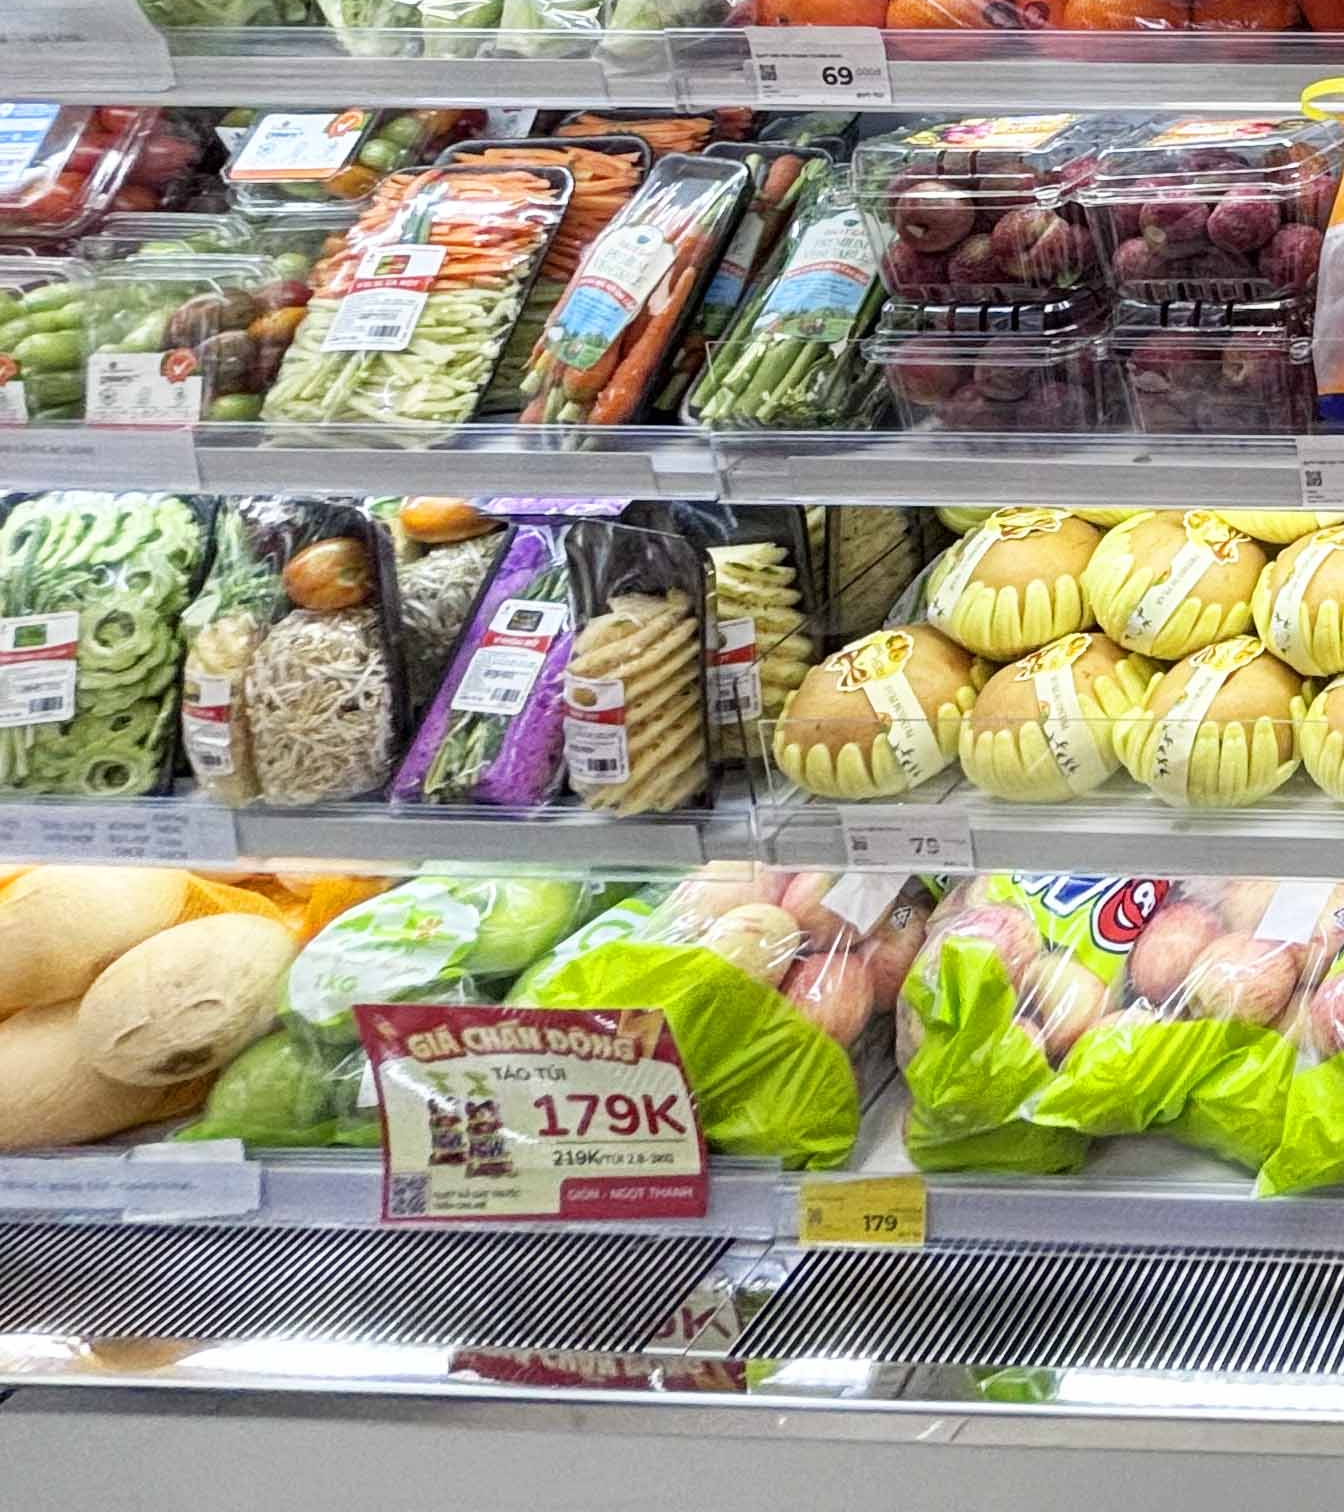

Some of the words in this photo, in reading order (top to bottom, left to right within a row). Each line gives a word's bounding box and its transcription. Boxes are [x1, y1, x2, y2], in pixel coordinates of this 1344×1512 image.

[820, 66, 853, 87] 69
[408, 1024, 463, 1062] GIÁ
[492, 1066, 531, 1082] TÁO
[533, 1093, 687, 1137] 179K
[862, 1213, 899, 1232] 179
